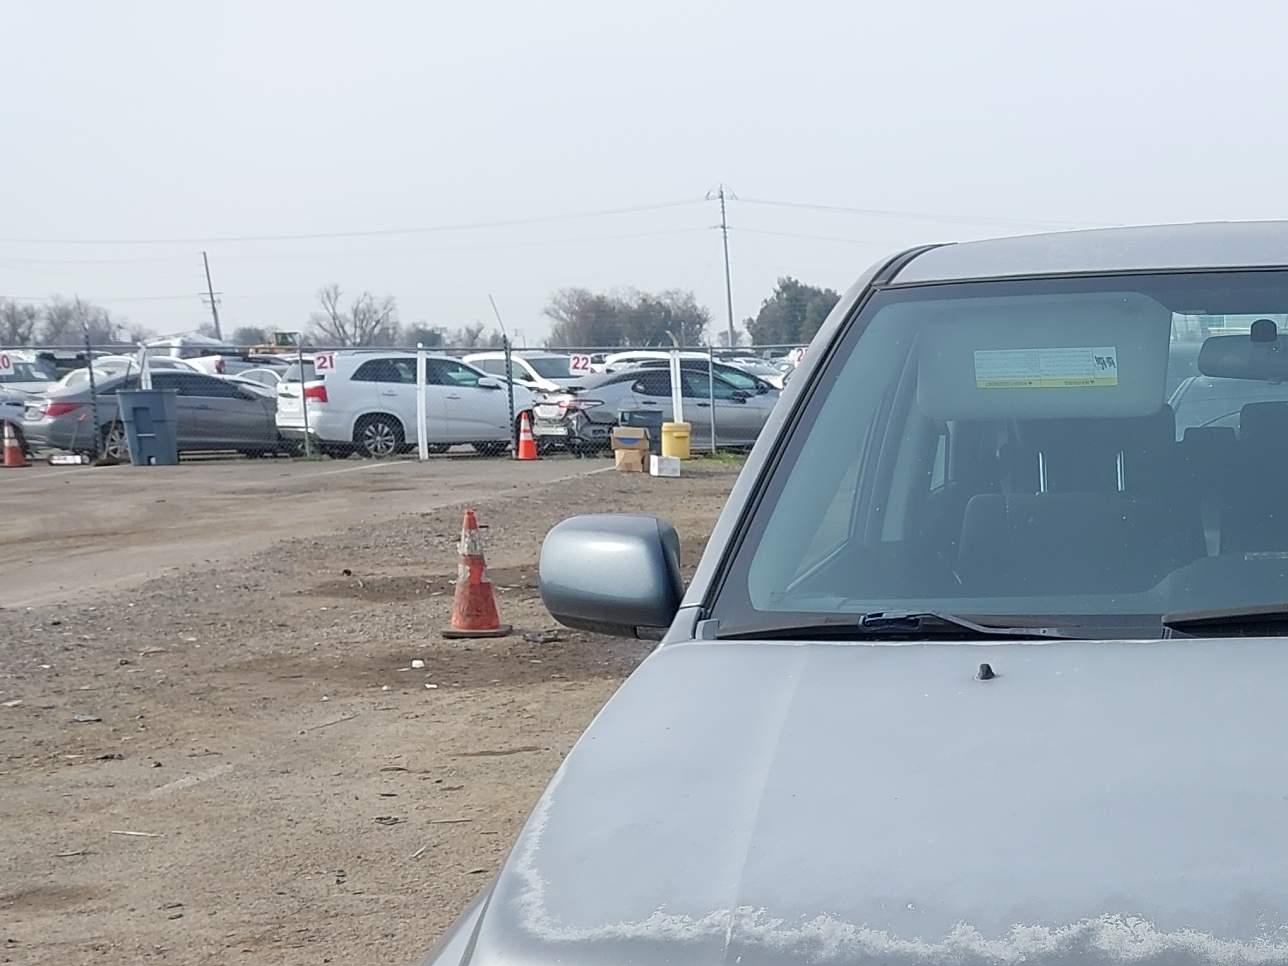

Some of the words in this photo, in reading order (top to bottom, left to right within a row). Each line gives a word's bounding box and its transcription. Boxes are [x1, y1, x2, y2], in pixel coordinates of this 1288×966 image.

[0, 354, 10, 369] 0
[316, 355, 334, 369] 21
[572, 356, 589, 370] 22
